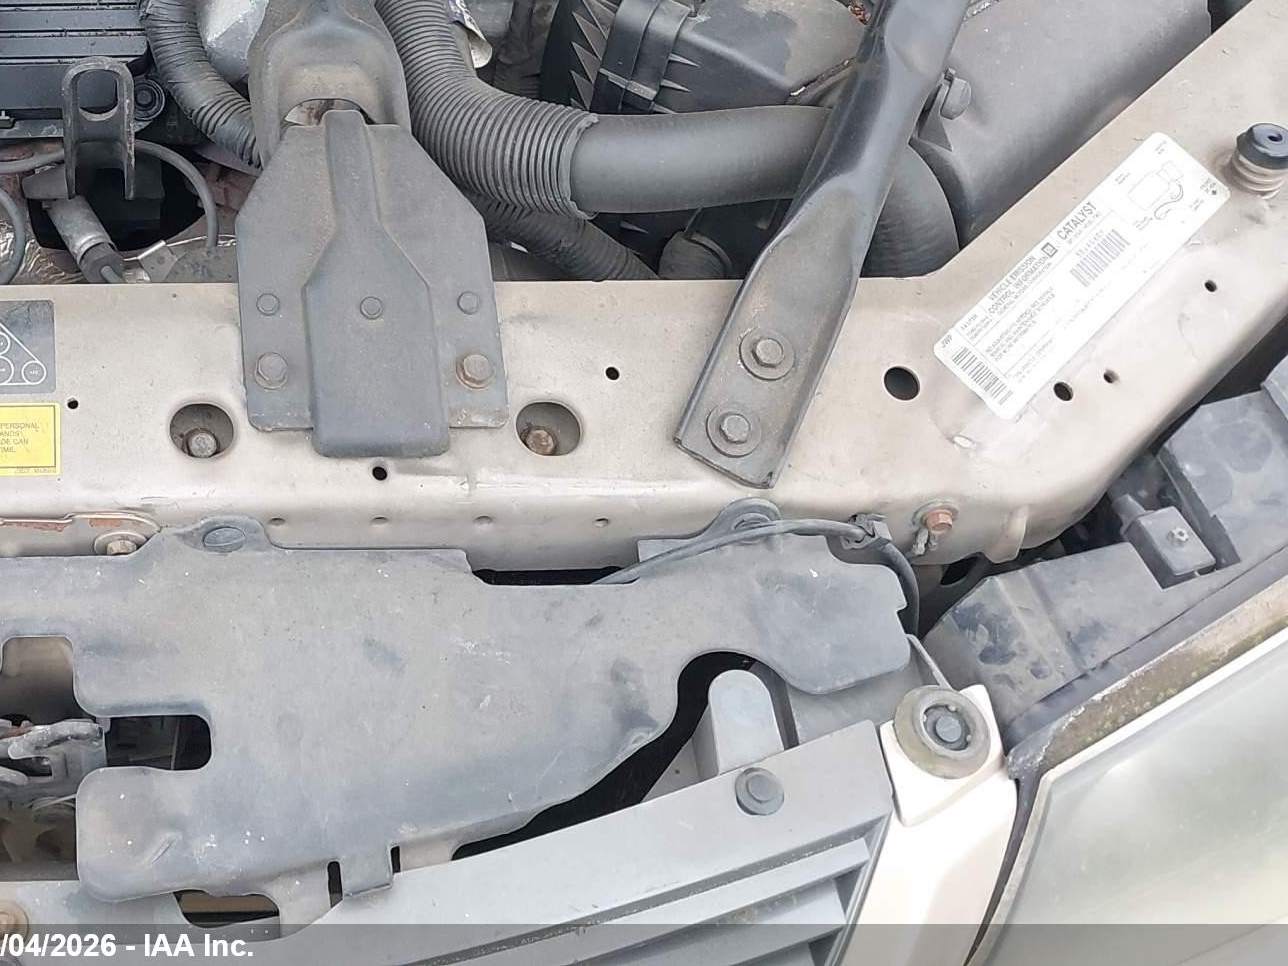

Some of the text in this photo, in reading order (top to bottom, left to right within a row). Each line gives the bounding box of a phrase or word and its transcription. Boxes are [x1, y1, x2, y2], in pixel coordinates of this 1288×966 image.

[1054, 200, 1097, 241] CATALYST
[986, 254, 1049, 314] CONTROL INFORMATION
[987, 254, 1036, 301] VEHICLE EMISSION
[0, 422, 40, 430] PERSONAL
